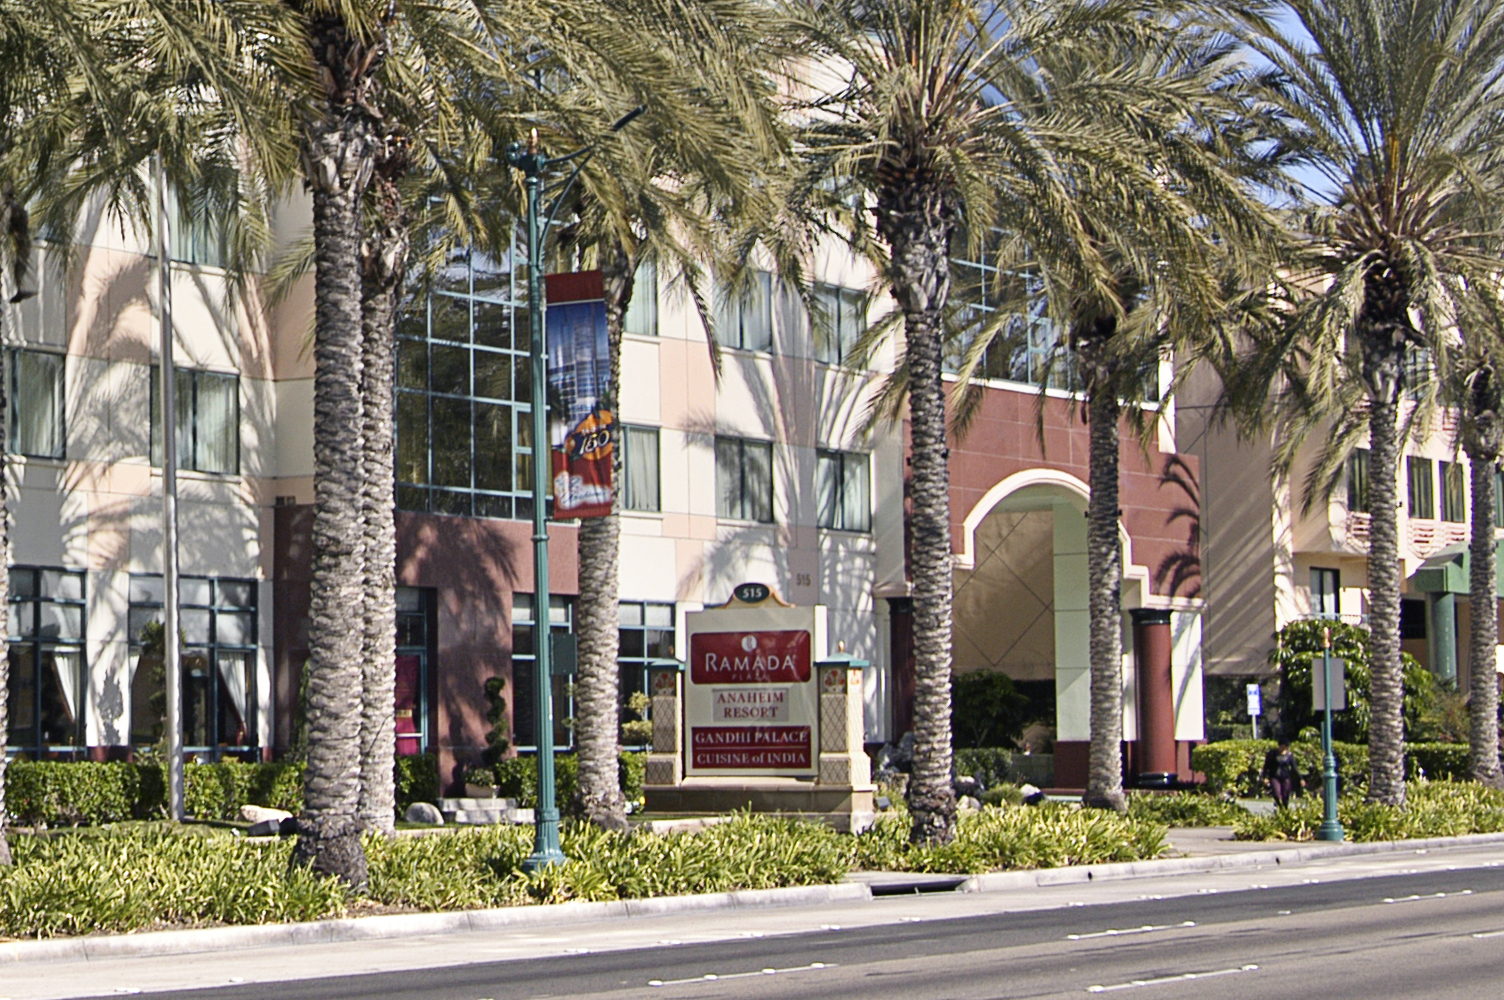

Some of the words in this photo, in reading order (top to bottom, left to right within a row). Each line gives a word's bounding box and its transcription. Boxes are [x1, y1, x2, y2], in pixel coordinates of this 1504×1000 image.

[796, 573, 812, 587] 515
[742, 588, 763, 599] 515
[705, 653, 795, 672] RAMADA
[717, 691, 784, 704] ANAHEIM
[723, 706, 779, 718] RESORT
[695, 732, 751, 744] GANDHI
[754, 730, 808, 743] PALACE
[697, 753, 750, 764] CUISINE
[752, 752, 765, 764] of
[767, 752, 806, 764] INDIA
